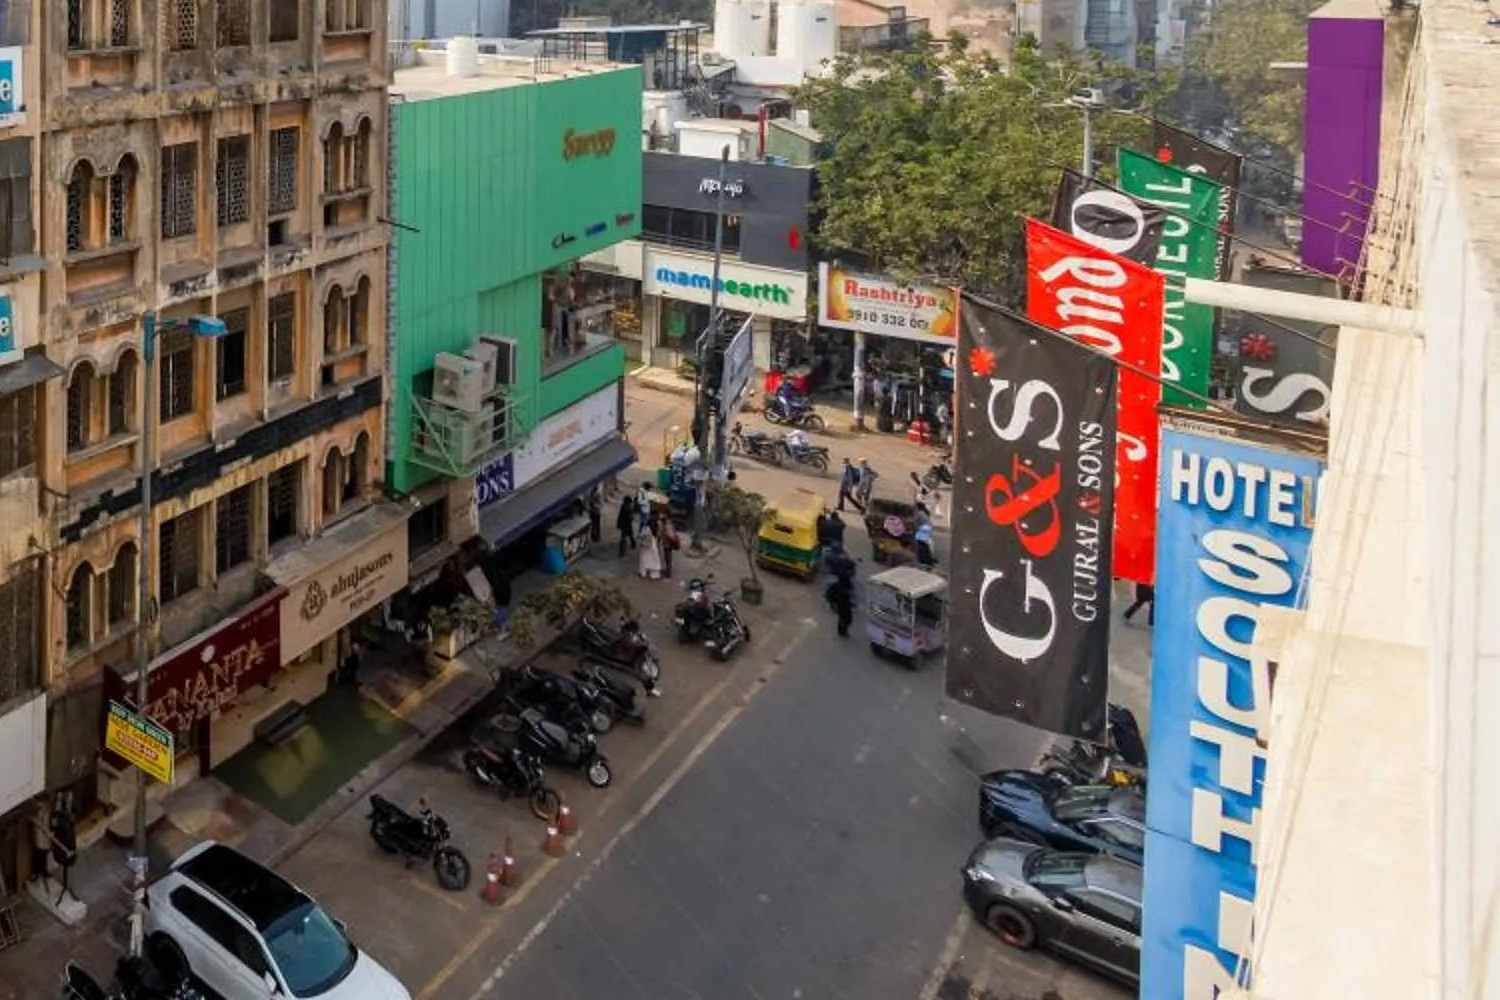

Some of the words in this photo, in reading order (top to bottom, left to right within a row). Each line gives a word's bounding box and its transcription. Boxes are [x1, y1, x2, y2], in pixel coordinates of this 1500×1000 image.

[1077, 421, 1103, 491] SONS
[1171, 449, 1317, 530] HOTEL
[1071, 519, 1100, 623] GUJRAL
